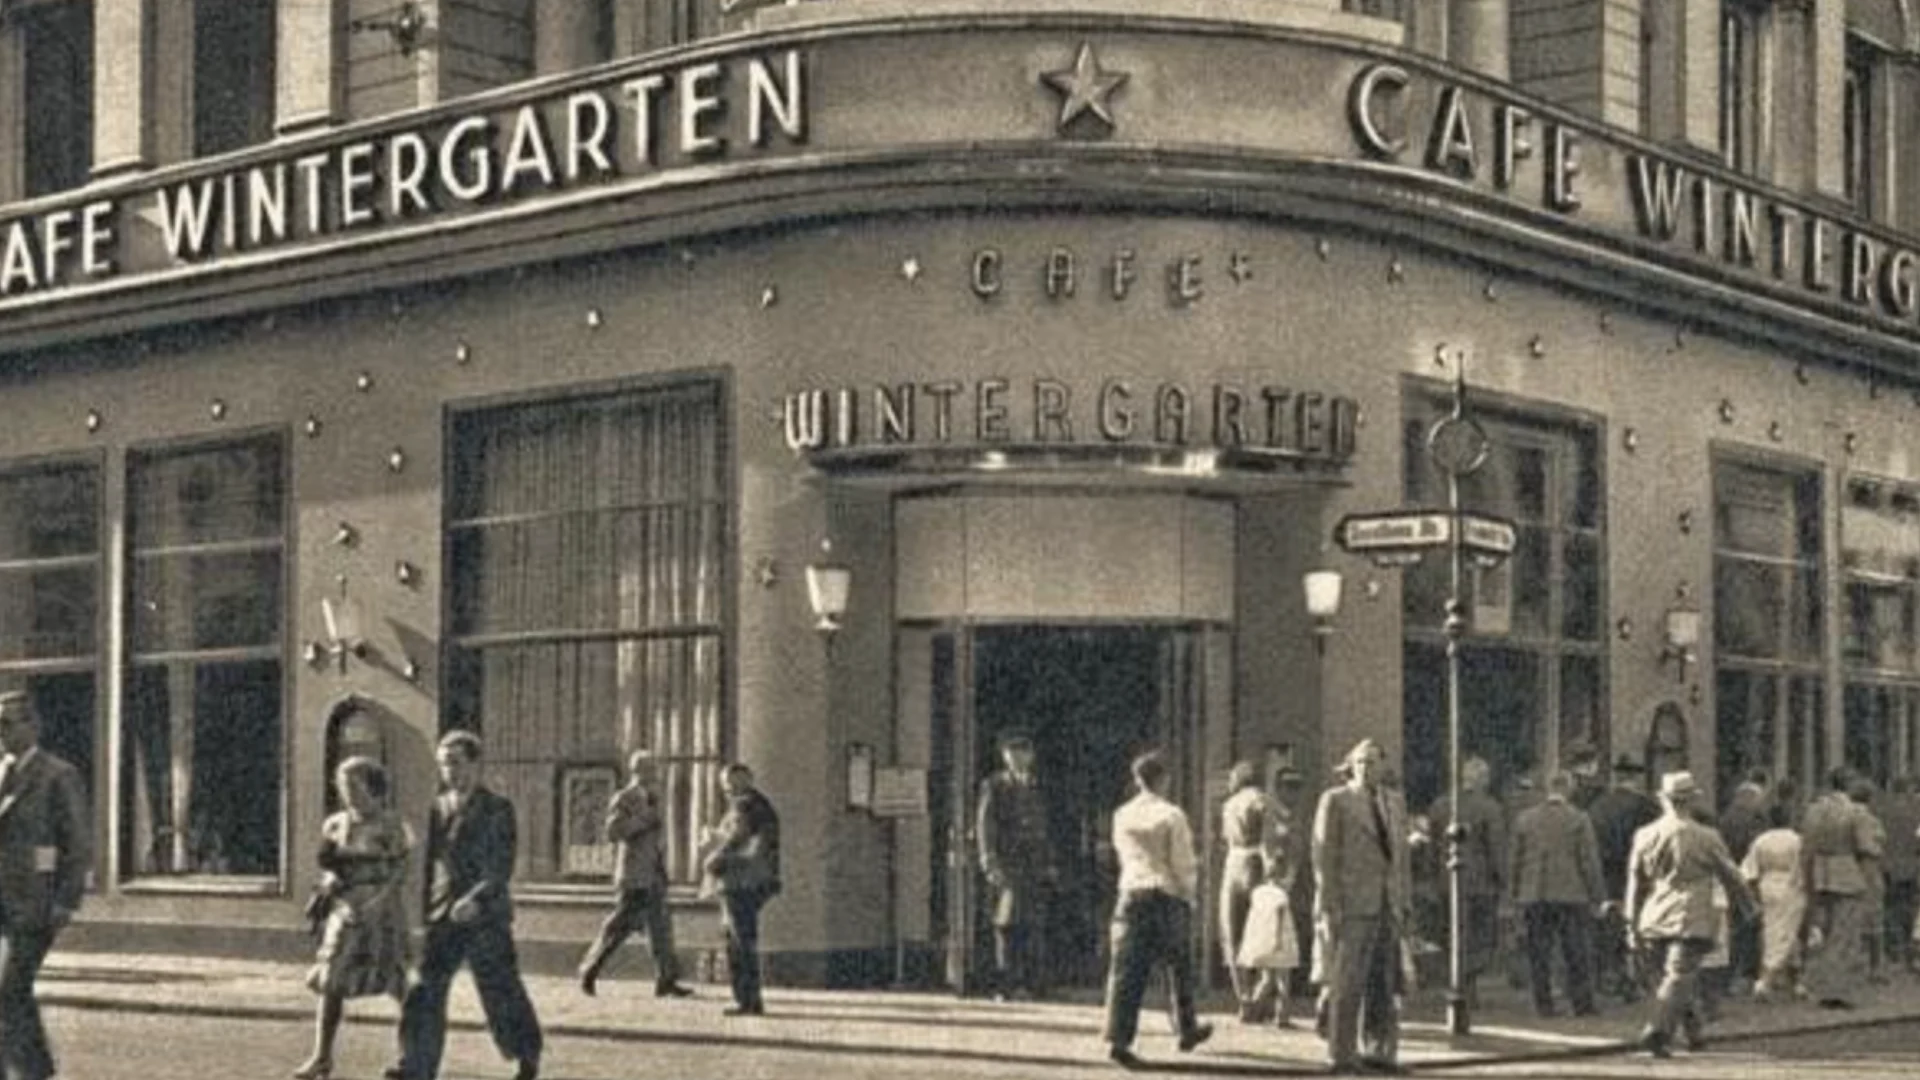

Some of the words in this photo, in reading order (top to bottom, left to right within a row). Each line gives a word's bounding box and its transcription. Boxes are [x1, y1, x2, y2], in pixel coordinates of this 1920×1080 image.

[155, 49, 807, 260] WINTERGARTEN
[1351, 63, 1581, 210] CAFE
[970, 246, 1203, 304] CAFE
[783, 377, 1359, 454] WINTERGARTEN
